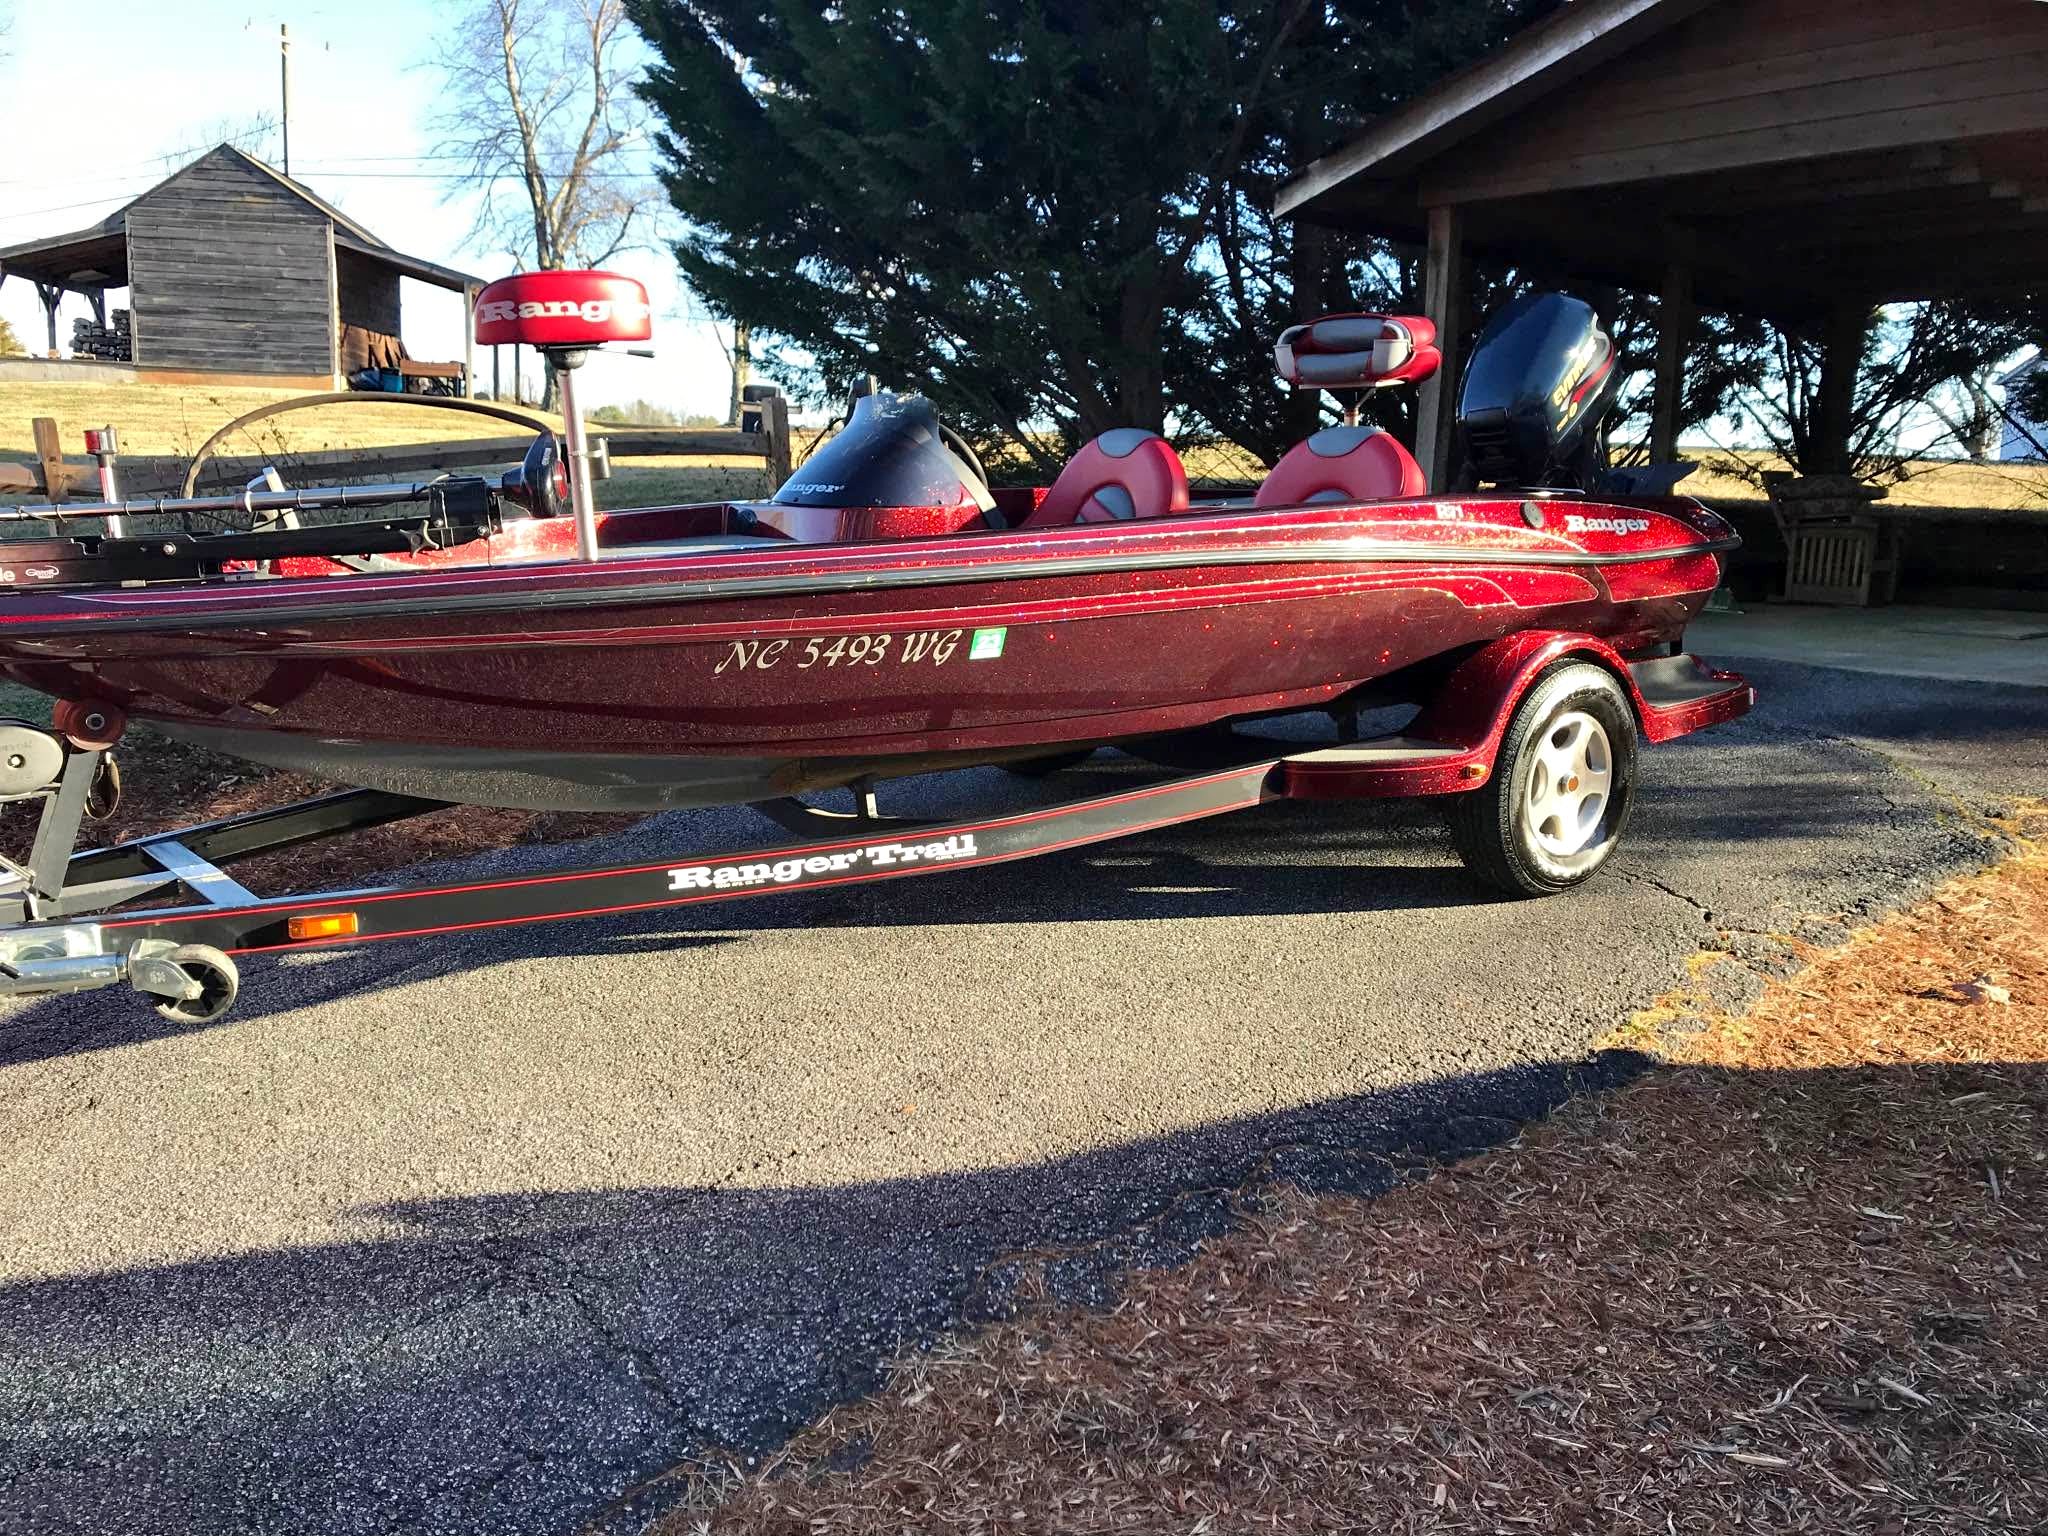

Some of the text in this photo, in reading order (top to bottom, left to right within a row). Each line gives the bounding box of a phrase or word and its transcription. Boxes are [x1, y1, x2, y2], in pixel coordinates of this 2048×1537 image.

[480, 299, 649, 324] Rang
[1564, 515, 1649, 536] Ranger
[714, 629, 963, 674] NC 5493 WG
[668, 834, 978, 890] Ranger Trail
